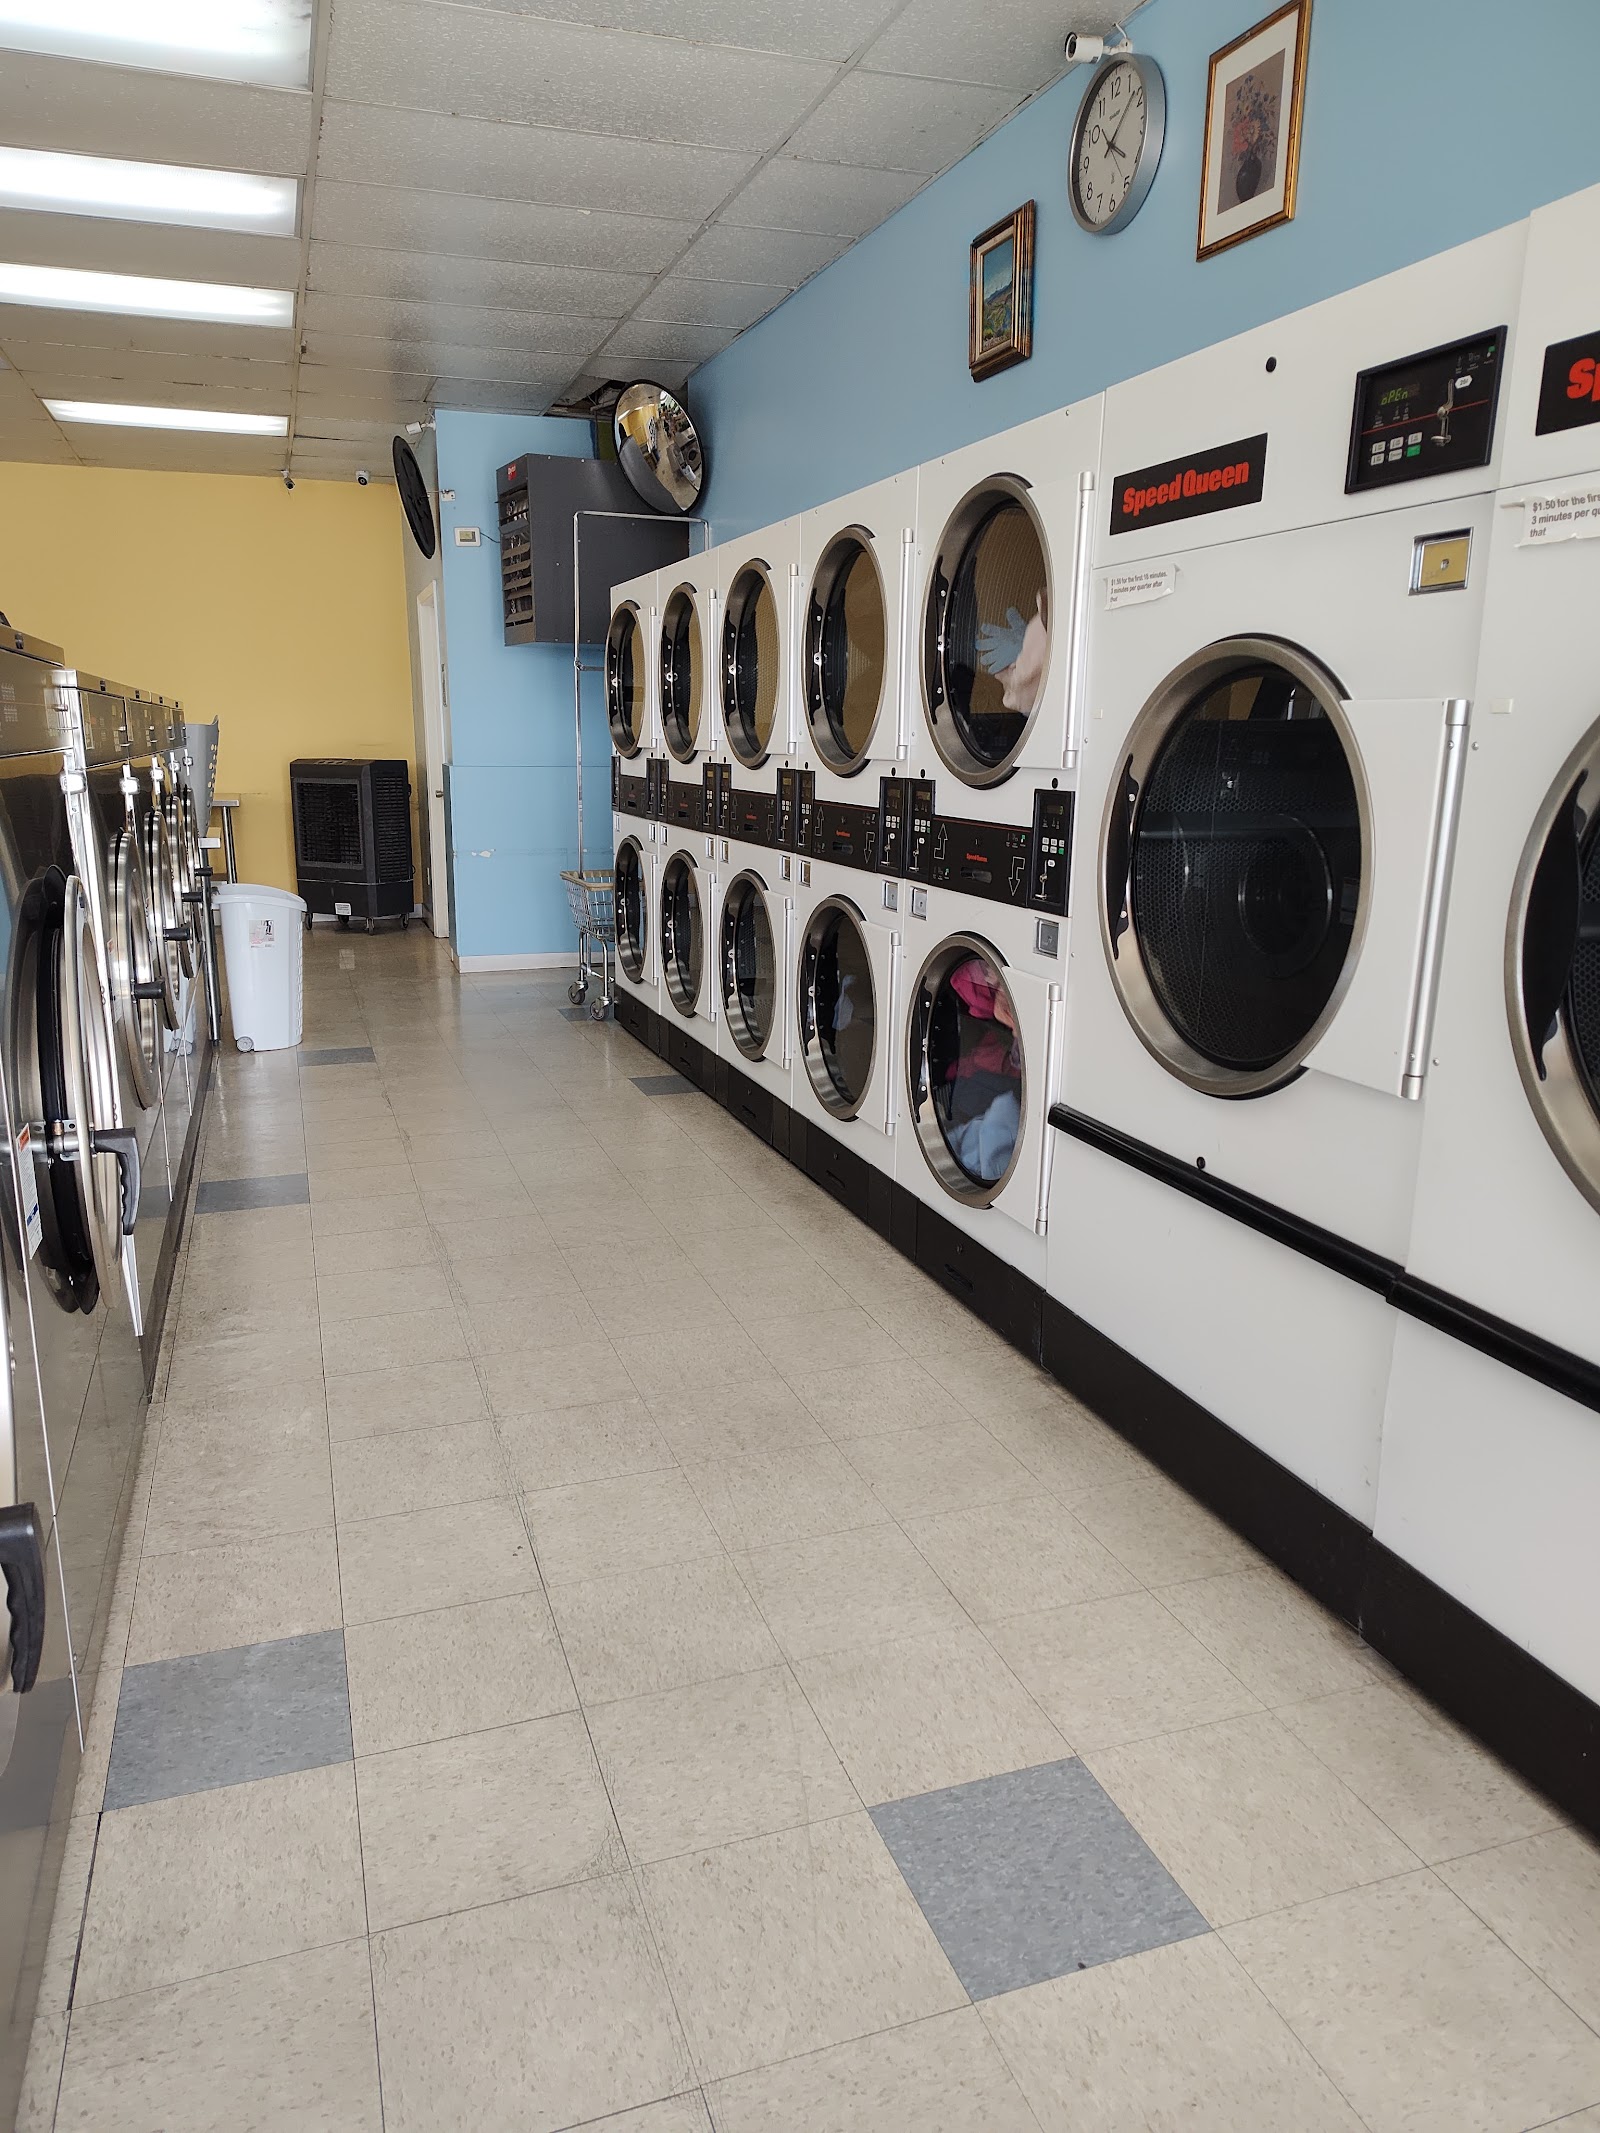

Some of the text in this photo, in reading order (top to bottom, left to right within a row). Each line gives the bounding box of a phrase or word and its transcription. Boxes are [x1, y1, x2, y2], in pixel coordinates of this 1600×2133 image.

[1111, 76, 1121, 101] 12
[1128, 73, 1132, 93] 1
[1136, 86, 1144, 108] 2
[1099, 97, 1106, 118] 11
[1087, 124, 1101, 149] 10
[1083, 156, 1090, 174] 9
[1086, 182, 1093, 201] 8
[1096, 193, 1103, 213] 7
[1108, 194, 1116, 213] 6
[1122, 461, 1250, 516] Speed Queen
[1532, 499, 1556, 513] $1.50
[1557, 498, 1570, 508] for
[1571, 496, 1586, 506] the
[1531, 515, 1537, 525] 3
[1538, 511, 1572, 525] minutes
[1574, 509, 1590, 521] per
[1530, 527, 1547, 538] that
[1114, 586, 1129, 594] minutes
[1137, 582, 1152, 591] quarter
[1153, 580, 1163, 588] after
[1135, 574, 1143, 582] first
